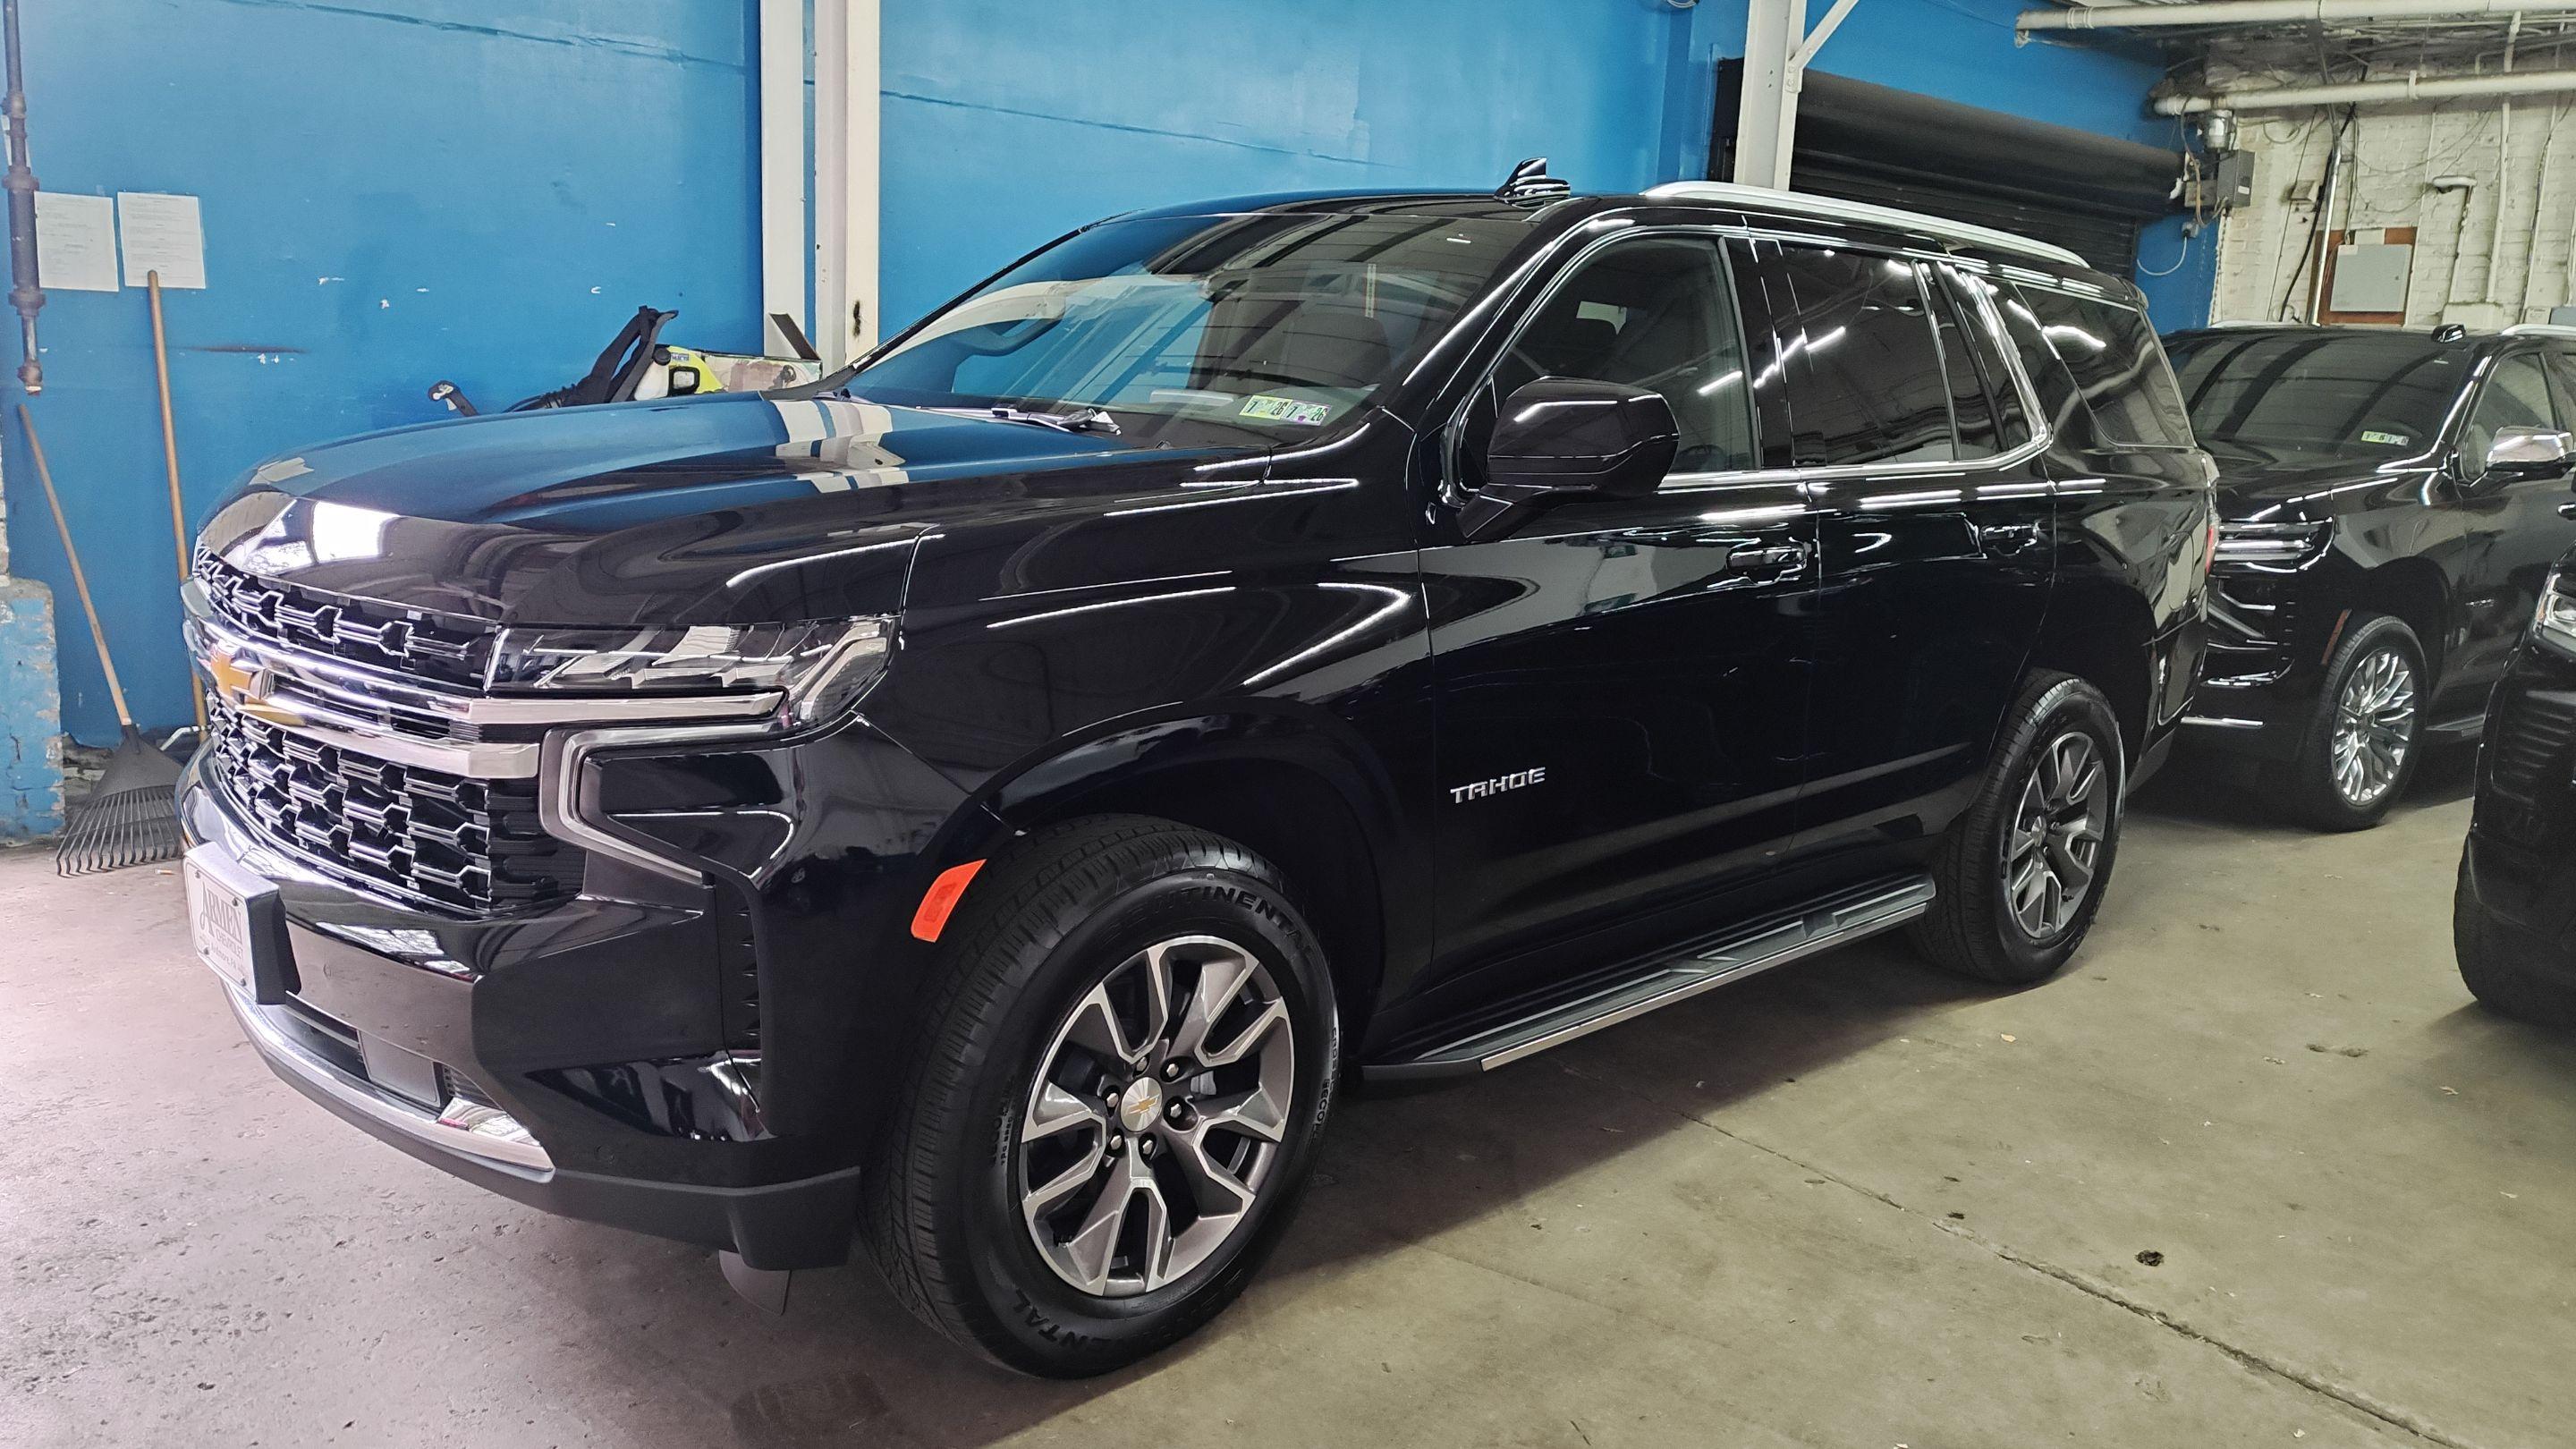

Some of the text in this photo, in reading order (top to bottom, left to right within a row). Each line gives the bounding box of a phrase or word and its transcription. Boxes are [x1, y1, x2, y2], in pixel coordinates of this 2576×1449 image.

[1270, 401, 1288, 416] 26
[1310, 407, 1328, 421] 26
[1450, 767, 1546, 804] TAHOE
